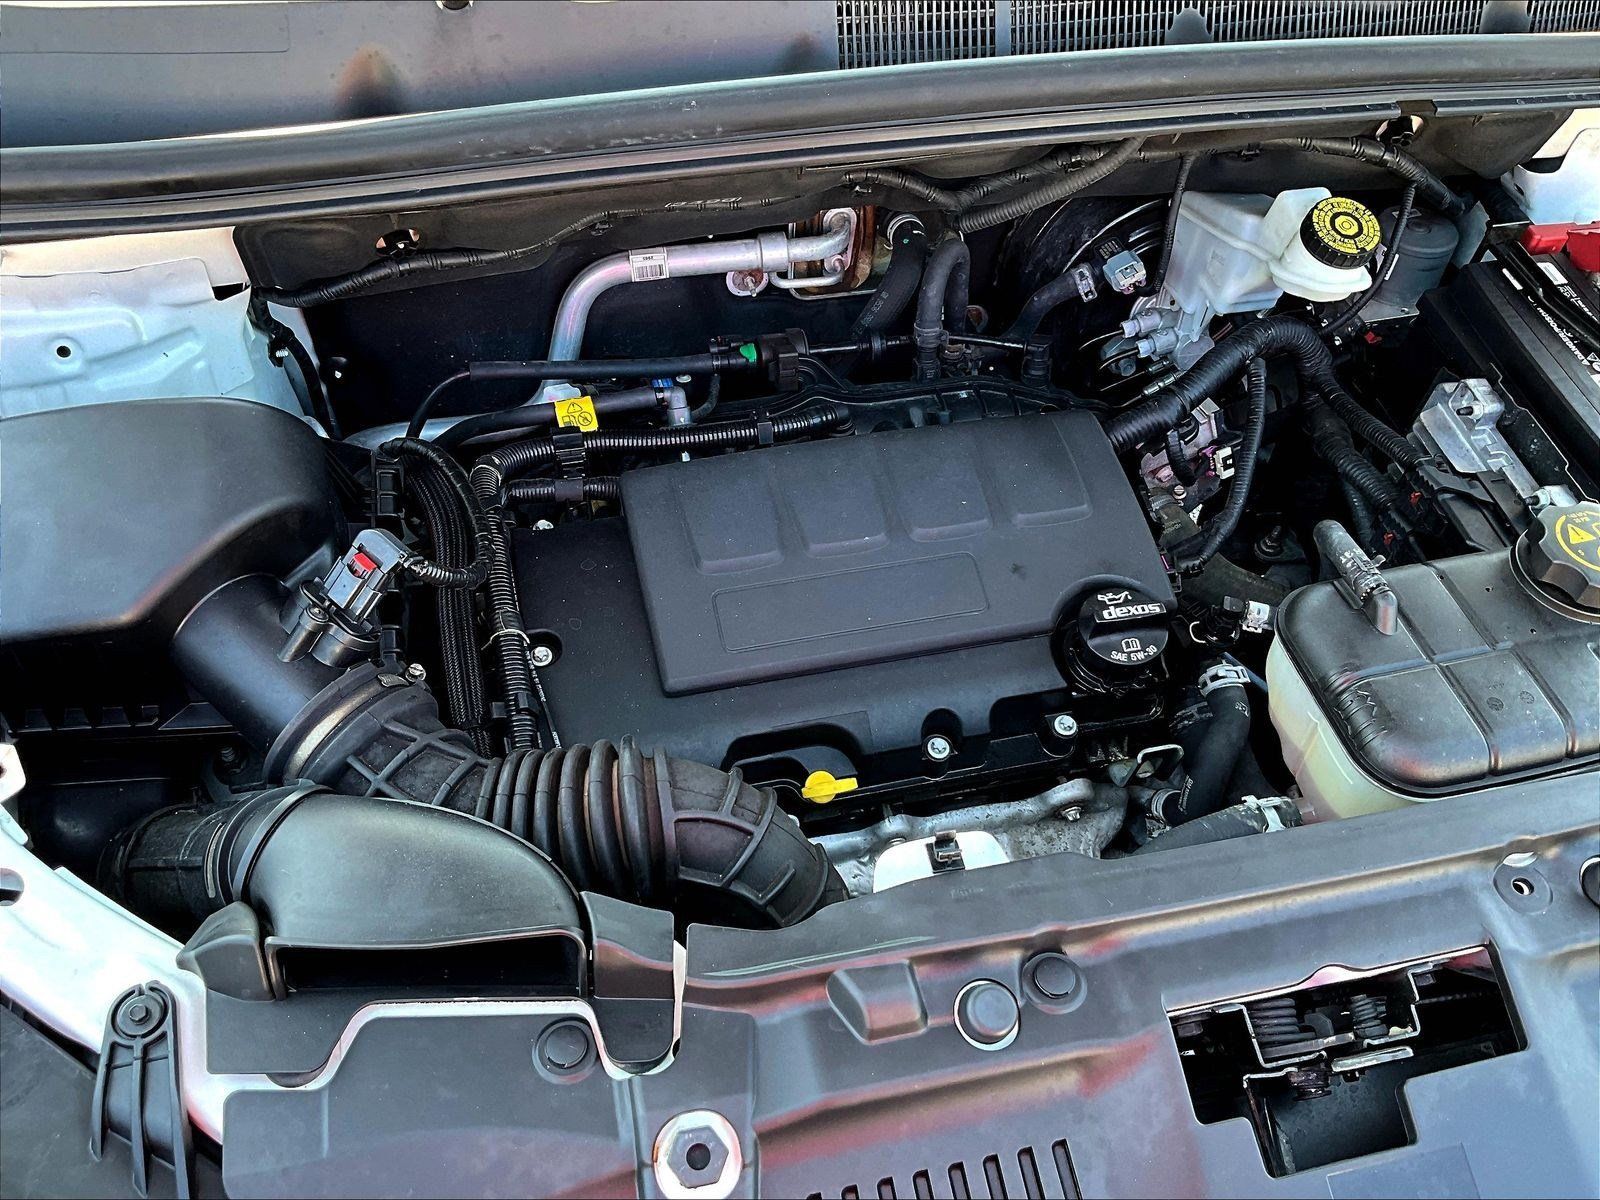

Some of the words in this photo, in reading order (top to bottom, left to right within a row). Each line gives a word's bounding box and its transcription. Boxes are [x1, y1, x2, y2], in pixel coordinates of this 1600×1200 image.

[1102, 603, 1161, 619] dexos
[1110, 650, 1128, 661] SAE
[1130, 645, 1158, 661] 5W-30
